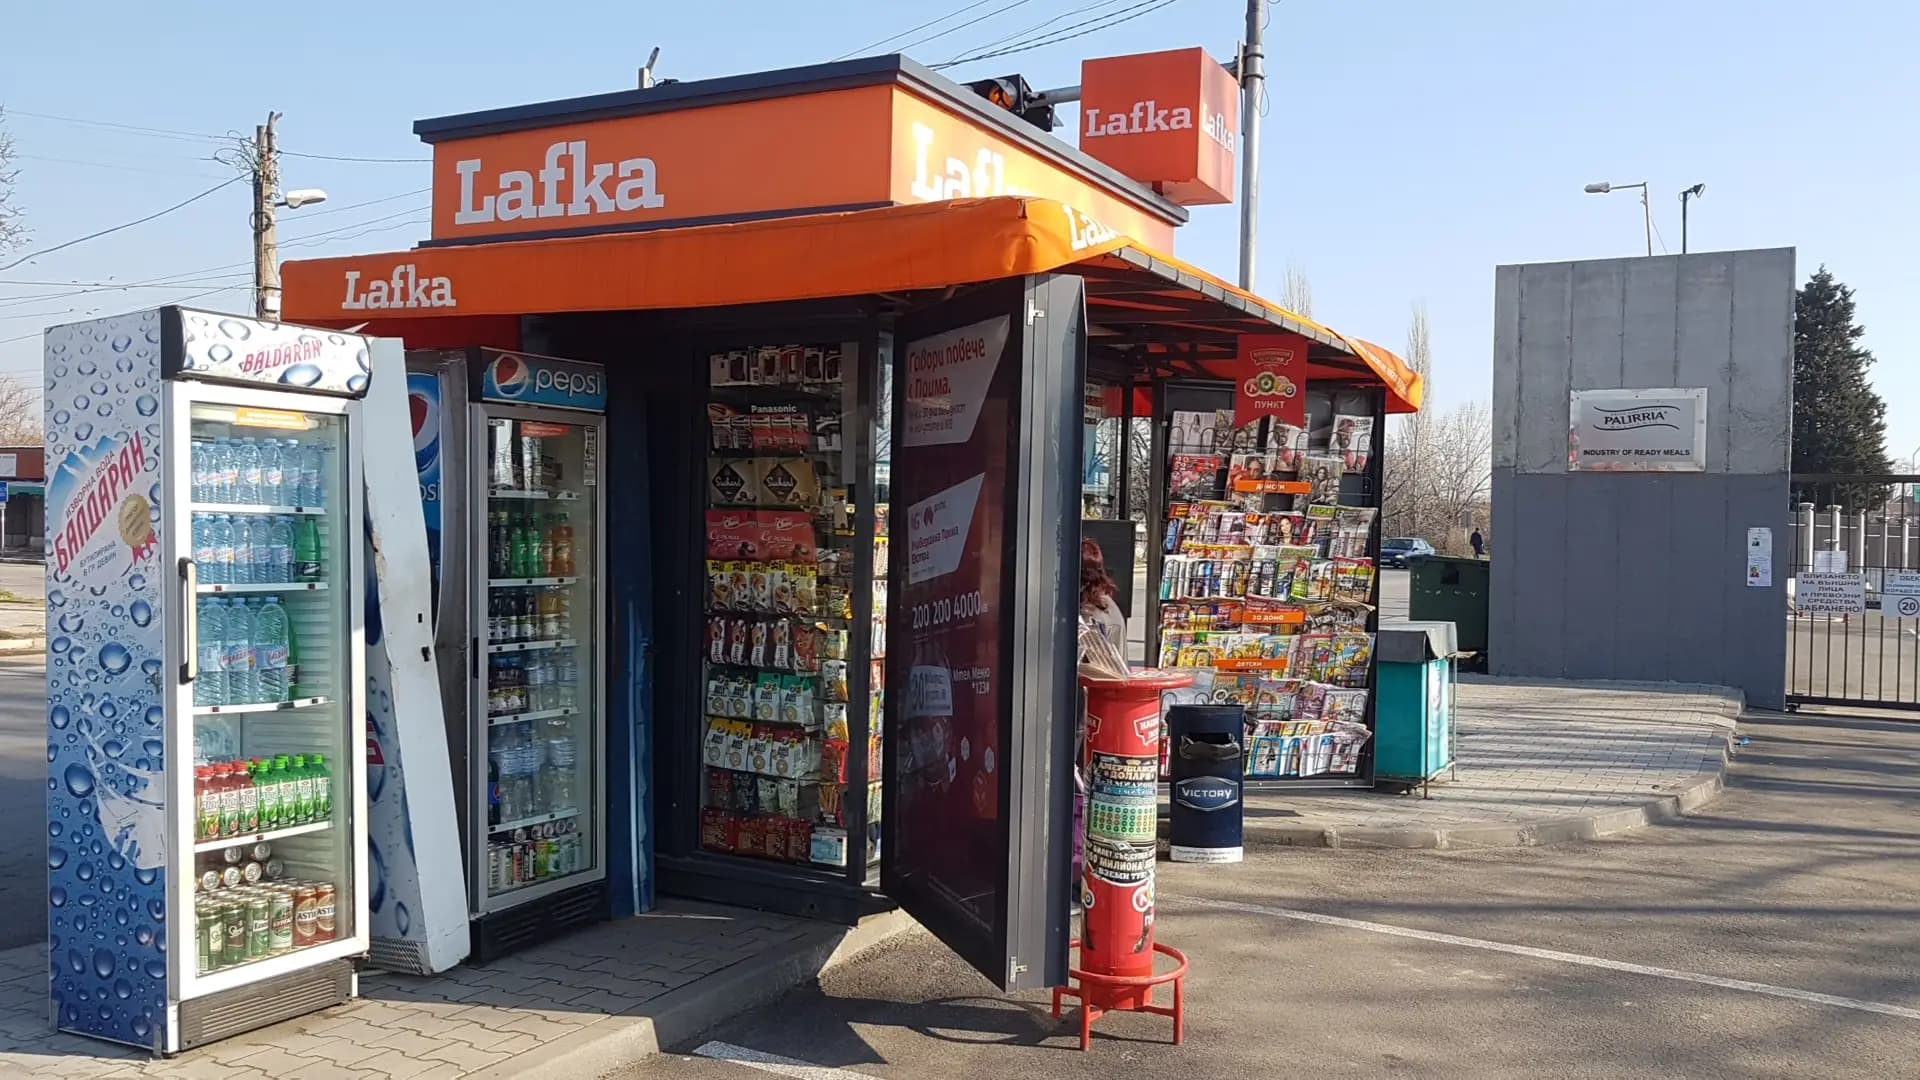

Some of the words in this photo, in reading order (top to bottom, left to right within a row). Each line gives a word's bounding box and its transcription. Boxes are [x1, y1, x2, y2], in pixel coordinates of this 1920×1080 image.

[1085, 101, 1193, 138] Lafka
[1202, 104, 1235, 153] Lafka
[455, 140, 665, 225] Lafka
[342, 264, 456, 310] Lafka
[946, 337, 985, 364] повече
[534, 368, 601, 398] pepsi
[751, 404, 797, 414] Panasonic
[1254, 400, 1285, 409] ПУНКТ
[1604, 412, 1665, 425] PALIRRIA
[96, 450, 115, 477] ВОДА
[54, 430, 145, 575] БАЛДАРАН
[912, 604, 930, 629] 200
[933, 598, 951, 625] 200
[1798, 604, 1863, 613] ЗАБРАНЕНО!
[1901, 602, 1916, 611] 20
[1182, 787, 1232, 800] VICTORY
